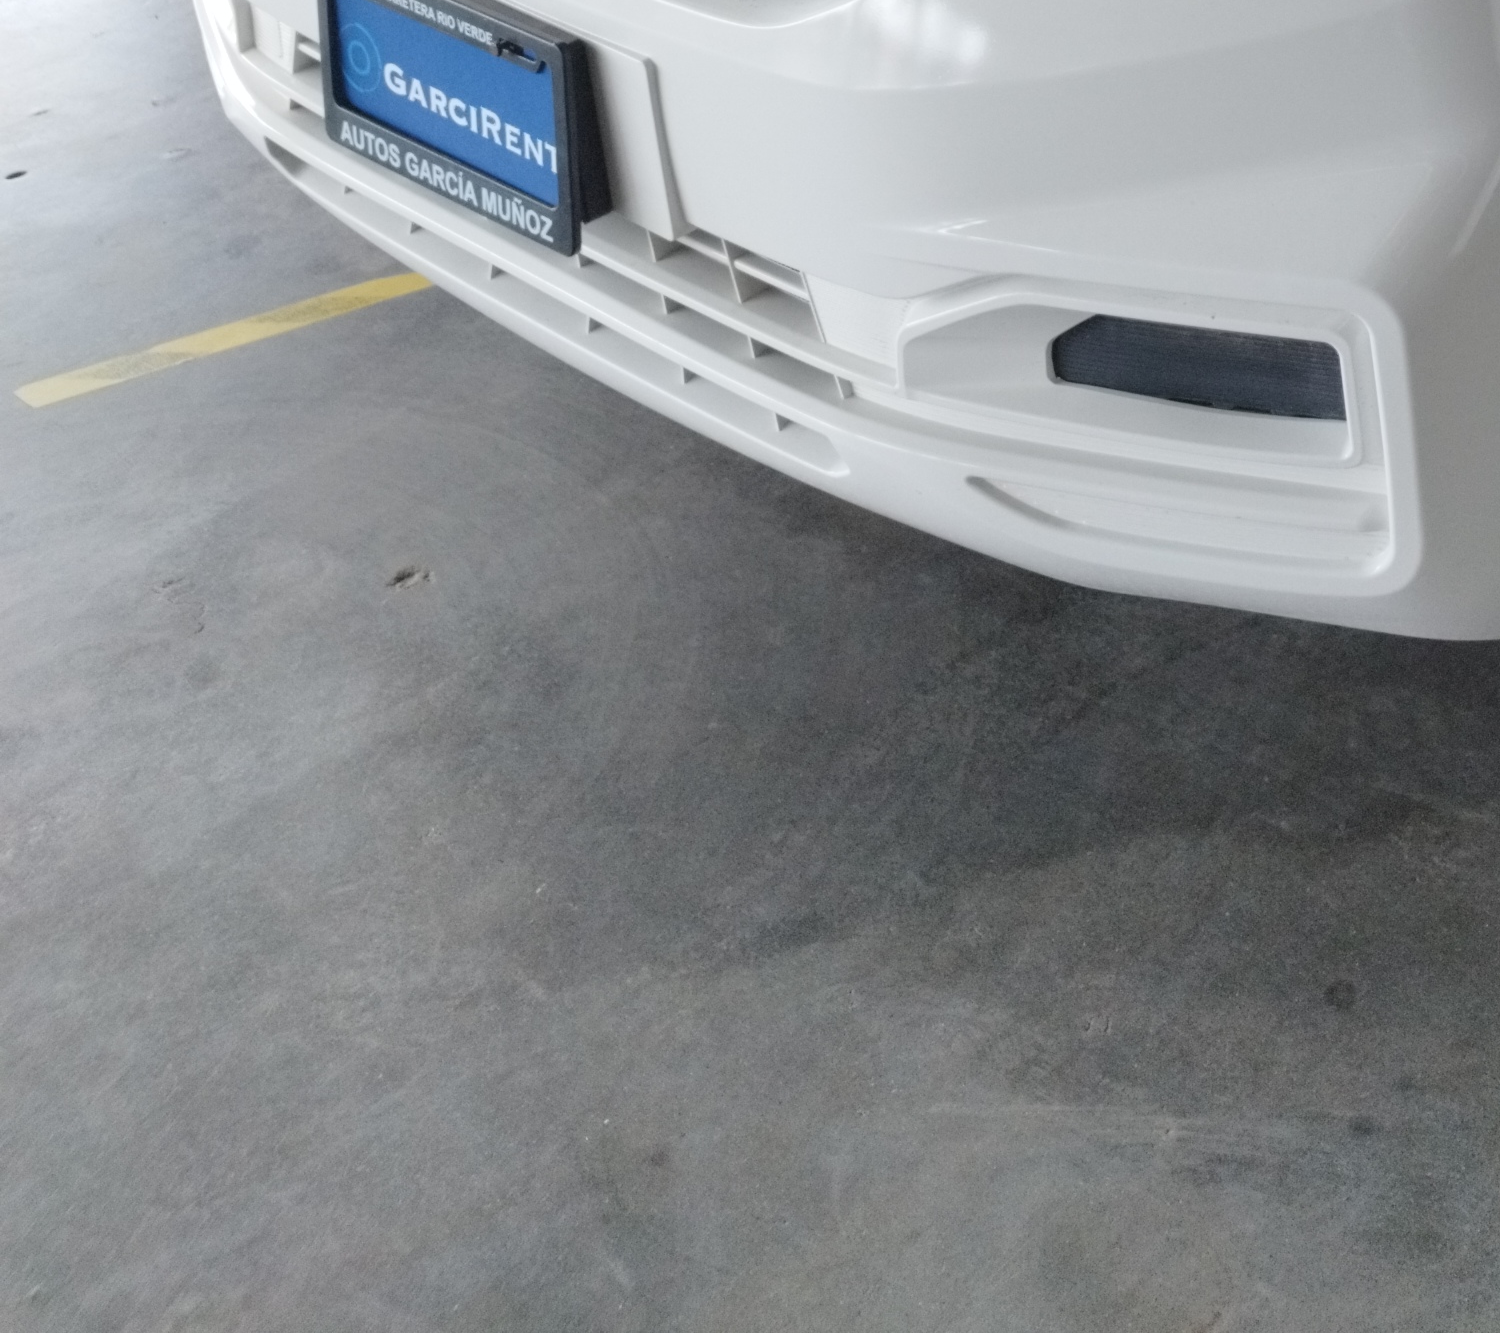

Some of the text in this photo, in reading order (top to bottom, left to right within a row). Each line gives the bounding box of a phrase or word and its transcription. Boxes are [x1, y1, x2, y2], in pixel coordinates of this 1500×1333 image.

[436, 9, 456, 29] RIO
[456, 17, 494, 46] VERDE
[341, 120, 555, 243] AUTOS GARCÍA MUÑOZ
